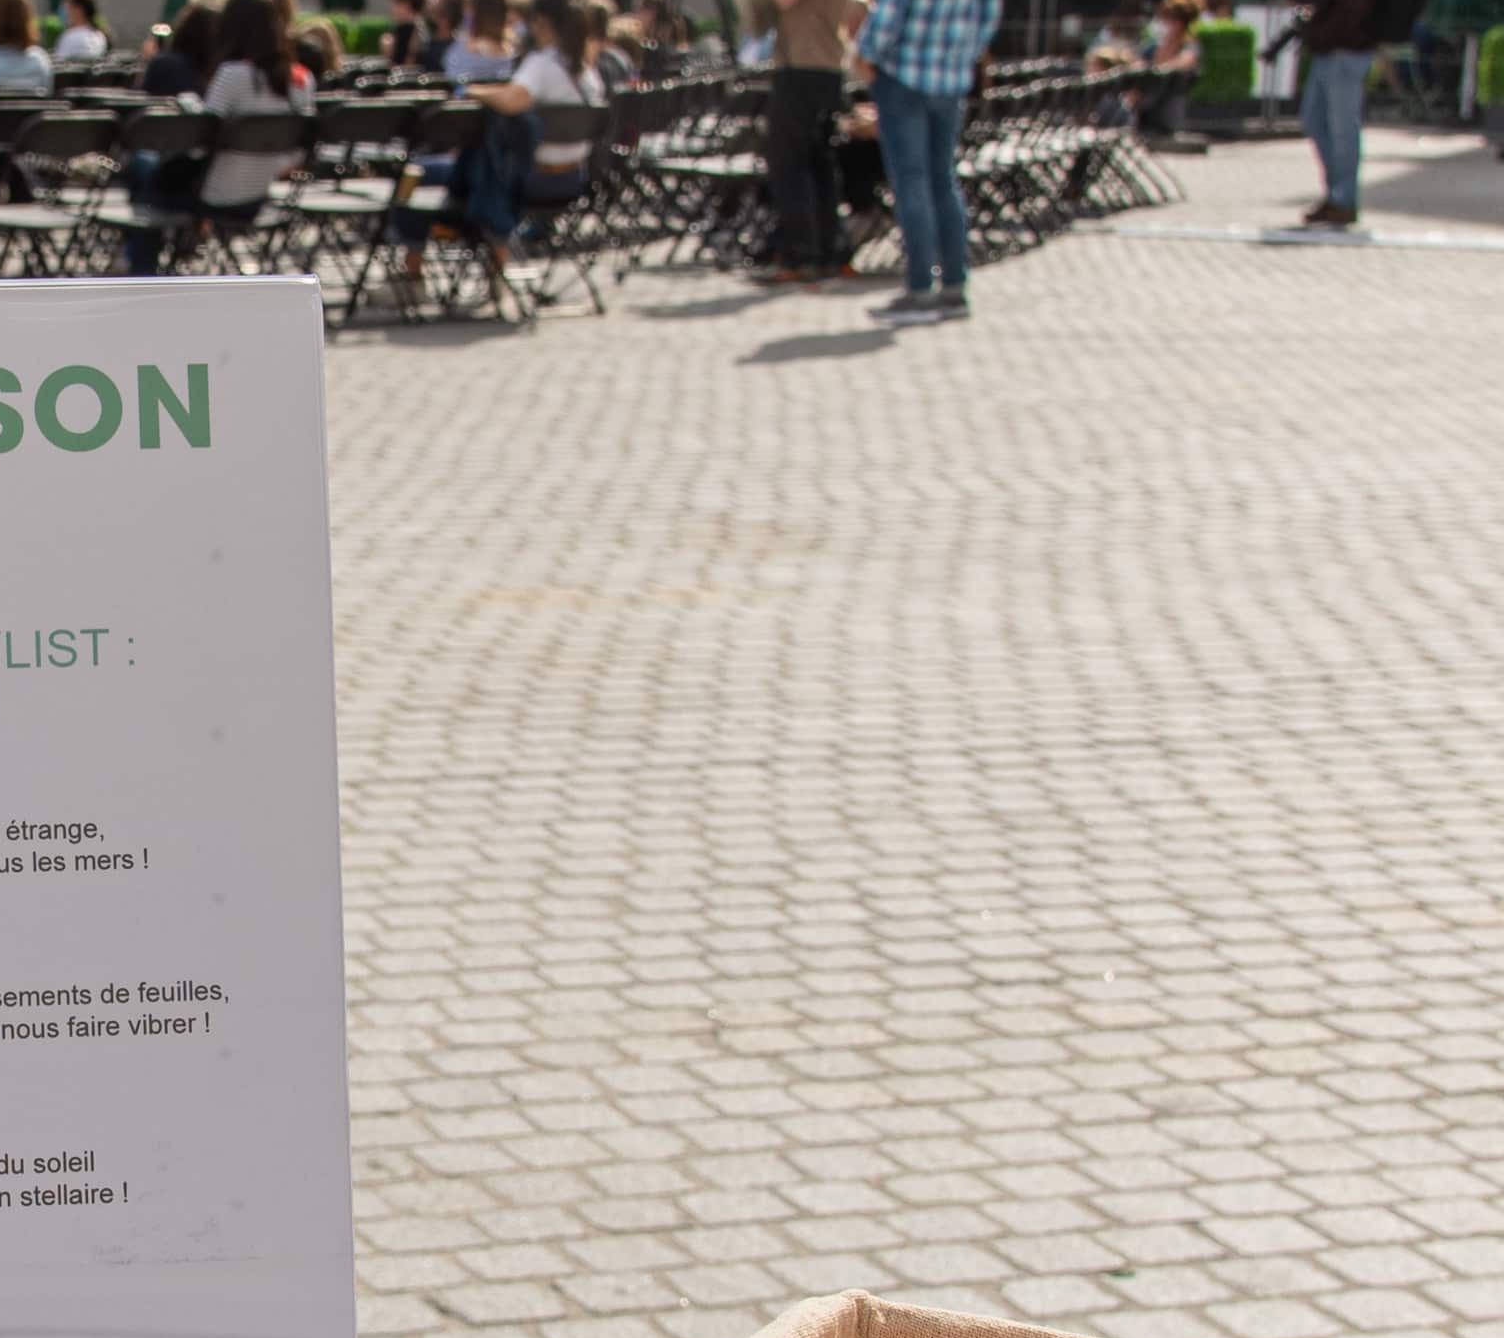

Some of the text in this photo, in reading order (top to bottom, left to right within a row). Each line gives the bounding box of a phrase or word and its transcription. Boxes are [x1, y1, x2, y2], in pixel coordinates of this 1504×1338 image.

[6, 819, 104, 844] étrange,
[33, 851, 66, 872] les
[75, 854, 134, 871] mers
[144, 848, 148, 869] !
[100, 983, 130, 1004] de
[137, 980, 228, 1004] feuilles,
[1, 1022, 59, 1040] nous
[66, 1015, 120, 1037] faire
[128, 1013, 197, 1035] vibrer
[205, 1011, 210, 1033] !
[33, 1150, 94, 1174] soleil
[20, 1183, 114, 1207] stellaire
[123, 1181, 128, 1203] !
